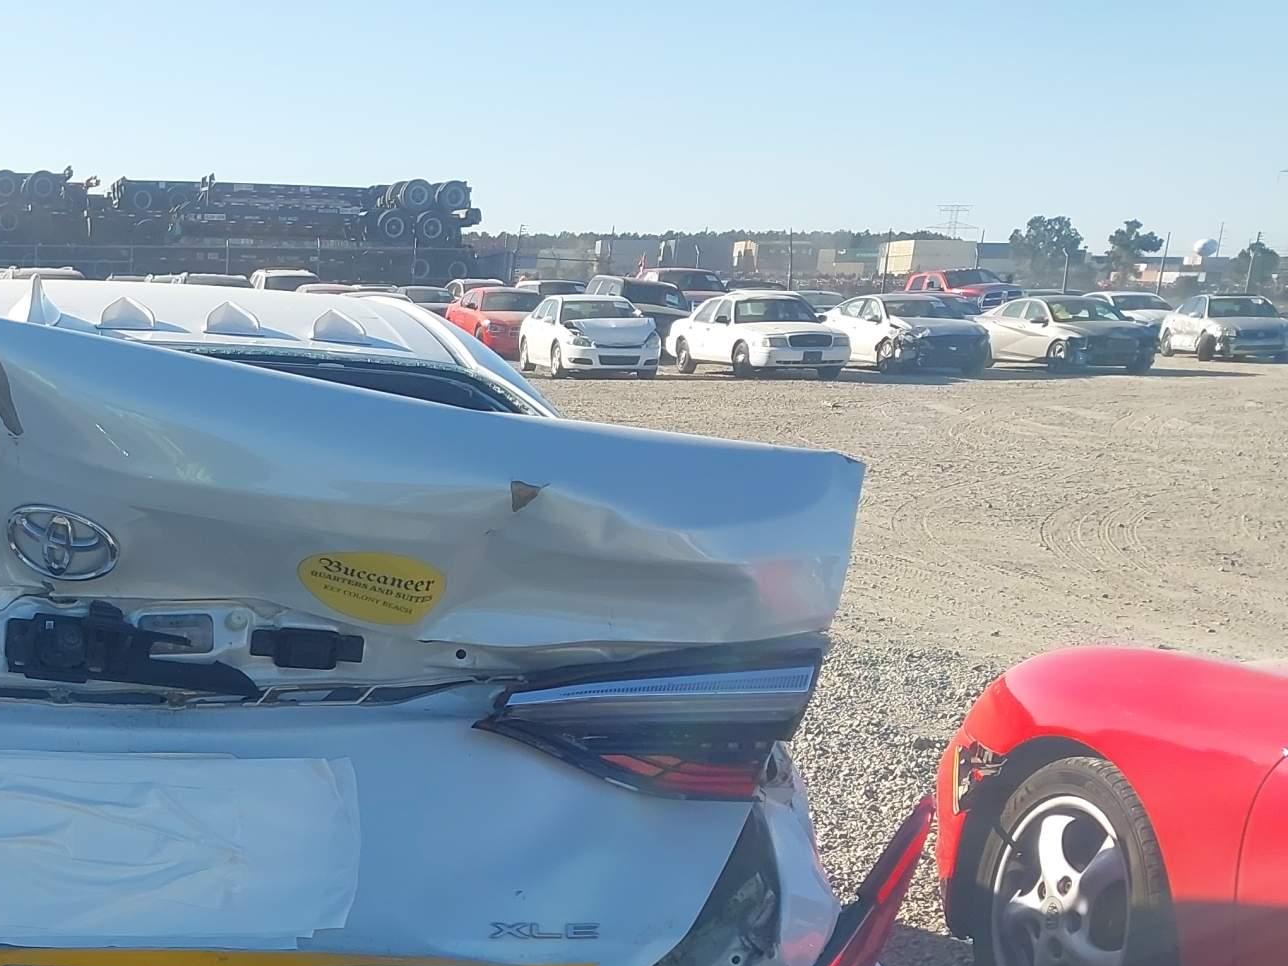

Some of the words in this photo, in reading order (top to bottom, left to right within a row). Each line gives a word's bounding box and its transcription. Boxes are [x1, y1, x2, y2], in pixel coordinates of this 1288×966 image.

[318, 557, 435, 592] Buccaneer
[343, 589, 381, 605] COLONY
[382, 601, 413, 615] BEACH
[369, 585, 393, 597] AND
[488, 921, 601, 940] XLE
